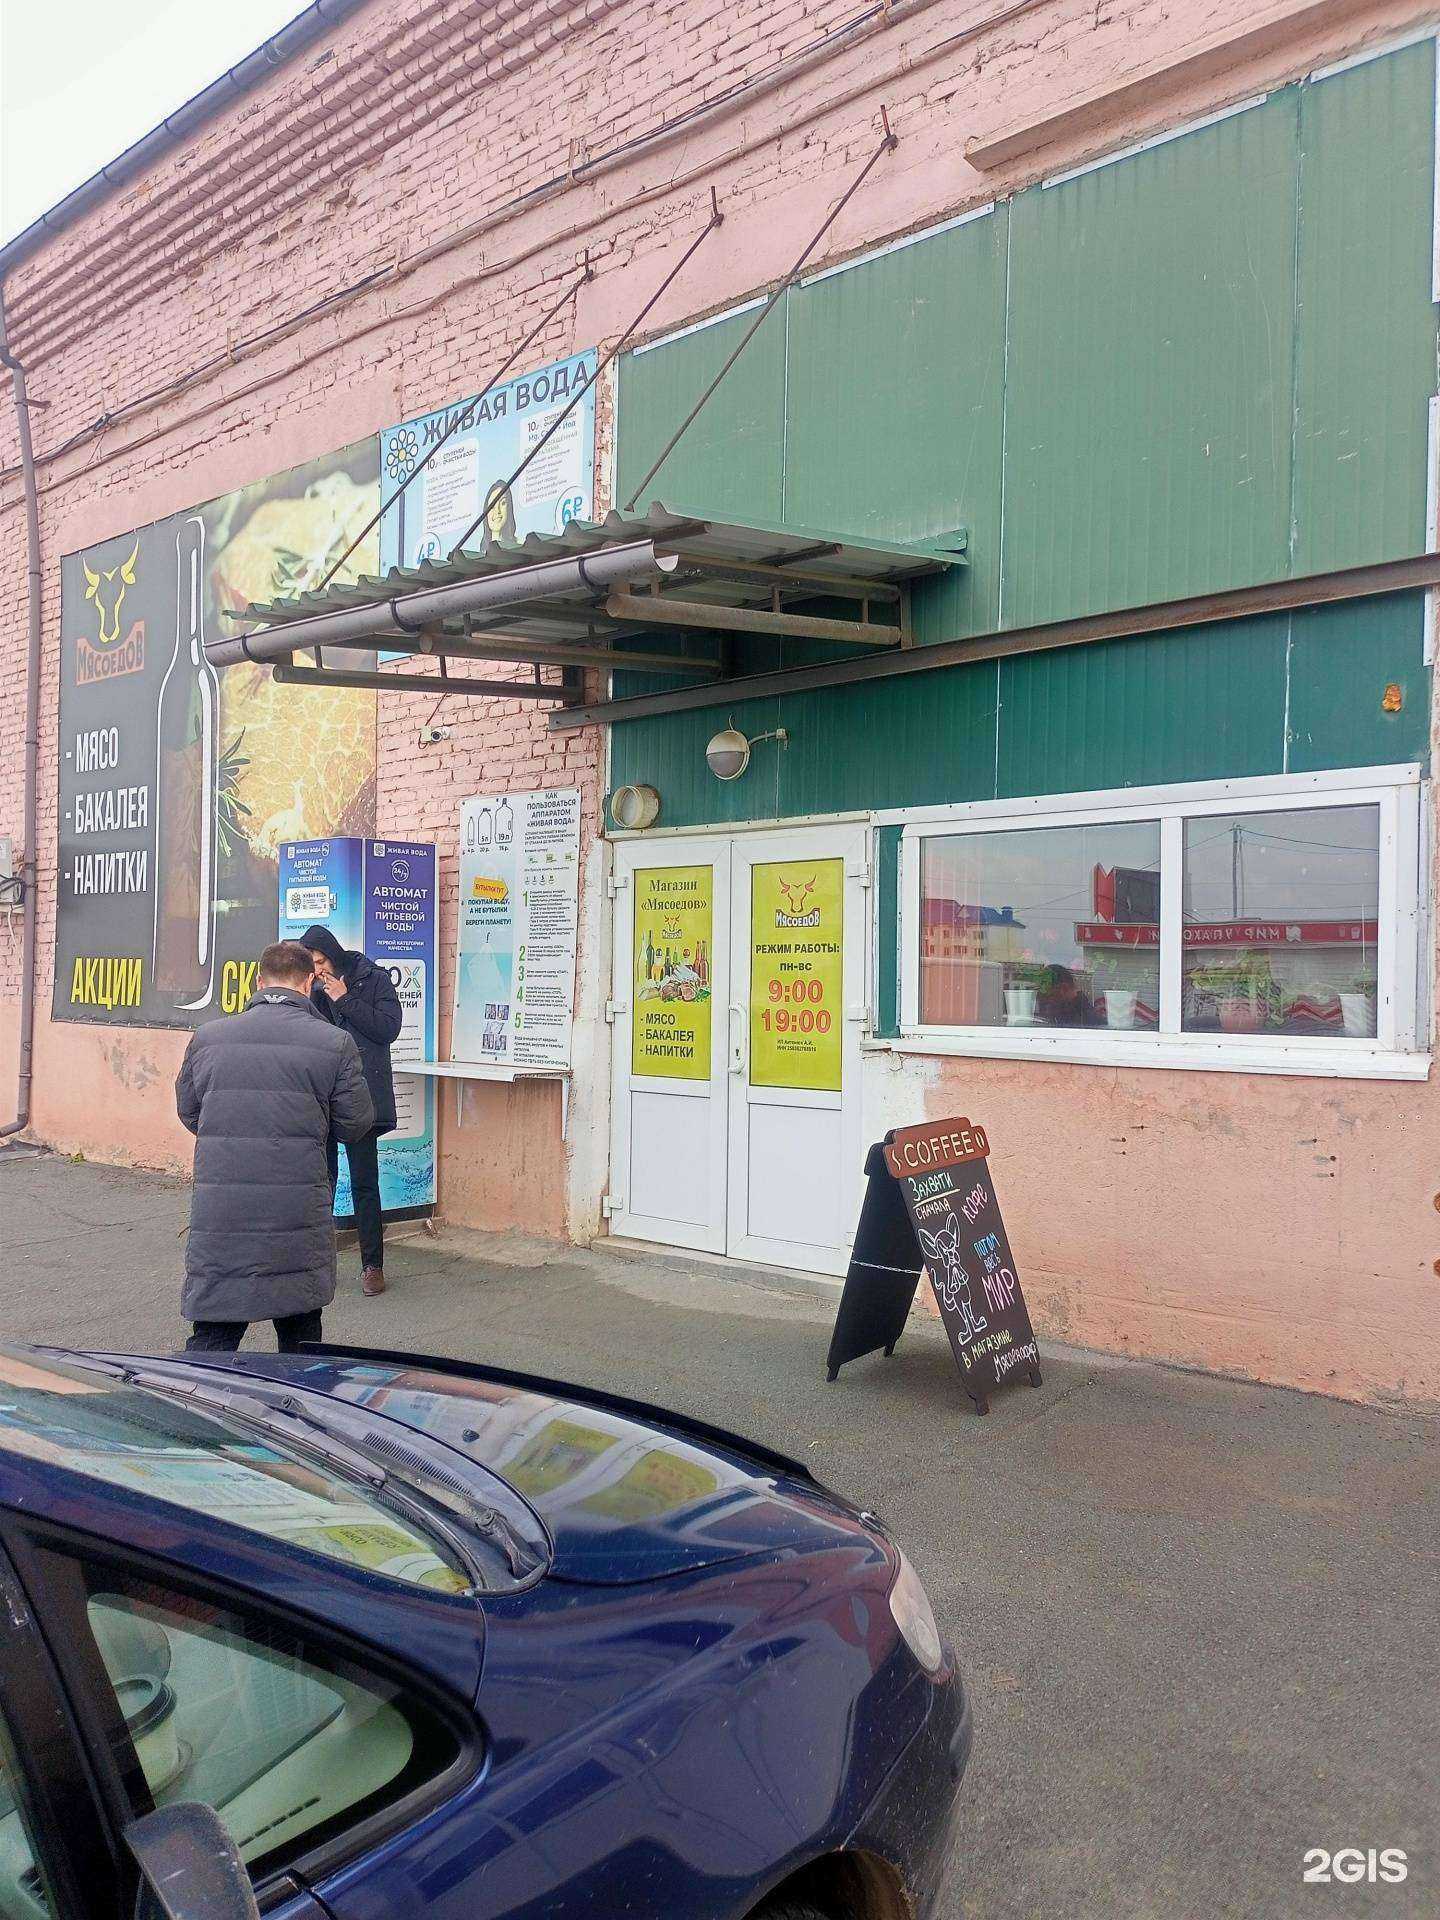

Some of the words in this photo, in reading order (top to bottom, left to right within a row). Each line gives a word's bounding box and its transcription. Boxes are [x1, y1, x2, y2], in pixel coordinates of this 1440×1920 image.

[423, 391, 507, 446] ЖИВАЯ
[516, 361, 589, 411] ВОДА
[75, 727, 119, 773] МЯСО
[75, 785, 148, 834] БАКАЛЕЯ
[74, 850, 148, 895] НАПИТКИ
[373, 886, 428, 899] АВТОМАТ
[650, 879, 697, 892] Магазин
[381, 901, 419, 912] ЧИСТОЙ
[640, 898, 707, 911] «Мясоедов»
[375, 910, 425, 921] ПИТЬЕВОЙ
[385, 922, 414, 932] ВОДЫ
[755, 943, 792, 954] РЕЖИМ
[794, 942, 840, 954] РАБОТЫ:
[70, 957, 143, 1011] АКЦИИ
[221, 960, 261, 1014] СК
[768, 979, 824, 1003] 9:00
[646, 1012, 676, 1025] МЯСО
[761, 1008, 832, 1033] 19:00
[645, 1029, 694, 1042] БАКАЛЕЯ
[645, 1044, 694, 1058] НАПИТКИ
[903, 1130, 974, 1168] COFFEE
[981, 1268, 1015, 1313] МИР
